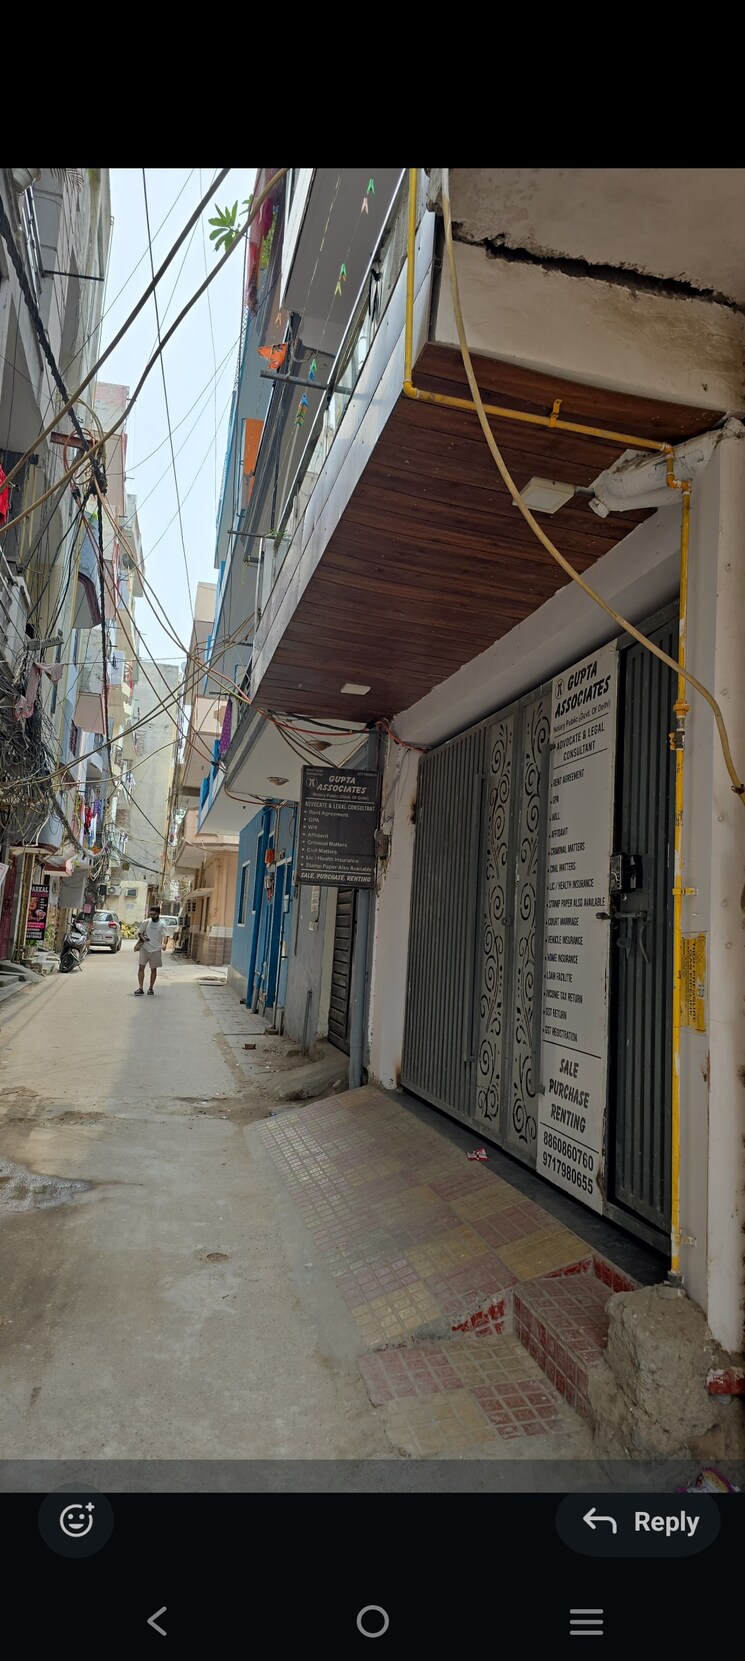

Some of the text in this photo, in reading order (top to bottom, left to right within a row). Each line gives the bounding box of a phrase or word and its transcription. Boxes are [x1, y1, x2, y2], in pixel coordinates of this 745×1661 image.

[567, 661, 597, 691] GUPTA
[555, 675, 611, 718] ASSOCIATES
[556, 722, 605, 750] ADVOCATE & LEGAL
[563, 740, 595, 761] CONSULTANT
[328, 775, 356, 785] GUPTA
[562, 768, 585, 783] AGREEMENT
[316, 784, 367, 794] ASSOCIATES
[304, 801, 328, 809] ADVOCATE
[347, 804, 375, 812] CONSULTANT
[551, 812, 560, 821] WILL
[567, 841, 585, 852] MATTERS
[559, 861, 576, 872] MATTERS
[346, 875, 371, 883] RENTING
[558, 880, 571, 890] HEALTH
[572, 878, 594, 889] INSURANCE
[548, 897, 605, 908] STAMP PAPER ALSO AVAILABLE
[548, 917, 559, 926] COURT
[547, 935, 583, 945] VEHICLE INSURANCE
[547, 953, 578, 964] HOME INSURANCE
[546, 970, 555, 980] LOAN
[546, 989, 559, 1000] INCOME
[567, 992, 583, 1004] RETURN
[552, 1008, 567, 1020] RETURN
[544, 1025, 578, 1043] GST REGISTRATION
[559, 1058, 579, 1078] SALE
[549, 1078, 590, 1109] PURCHASE
[551, 1103, 586, 1133] RENTING
[543, 1131, 594, 1171] 8860860760
[542, 1151, 593, 1195] 9717980655
